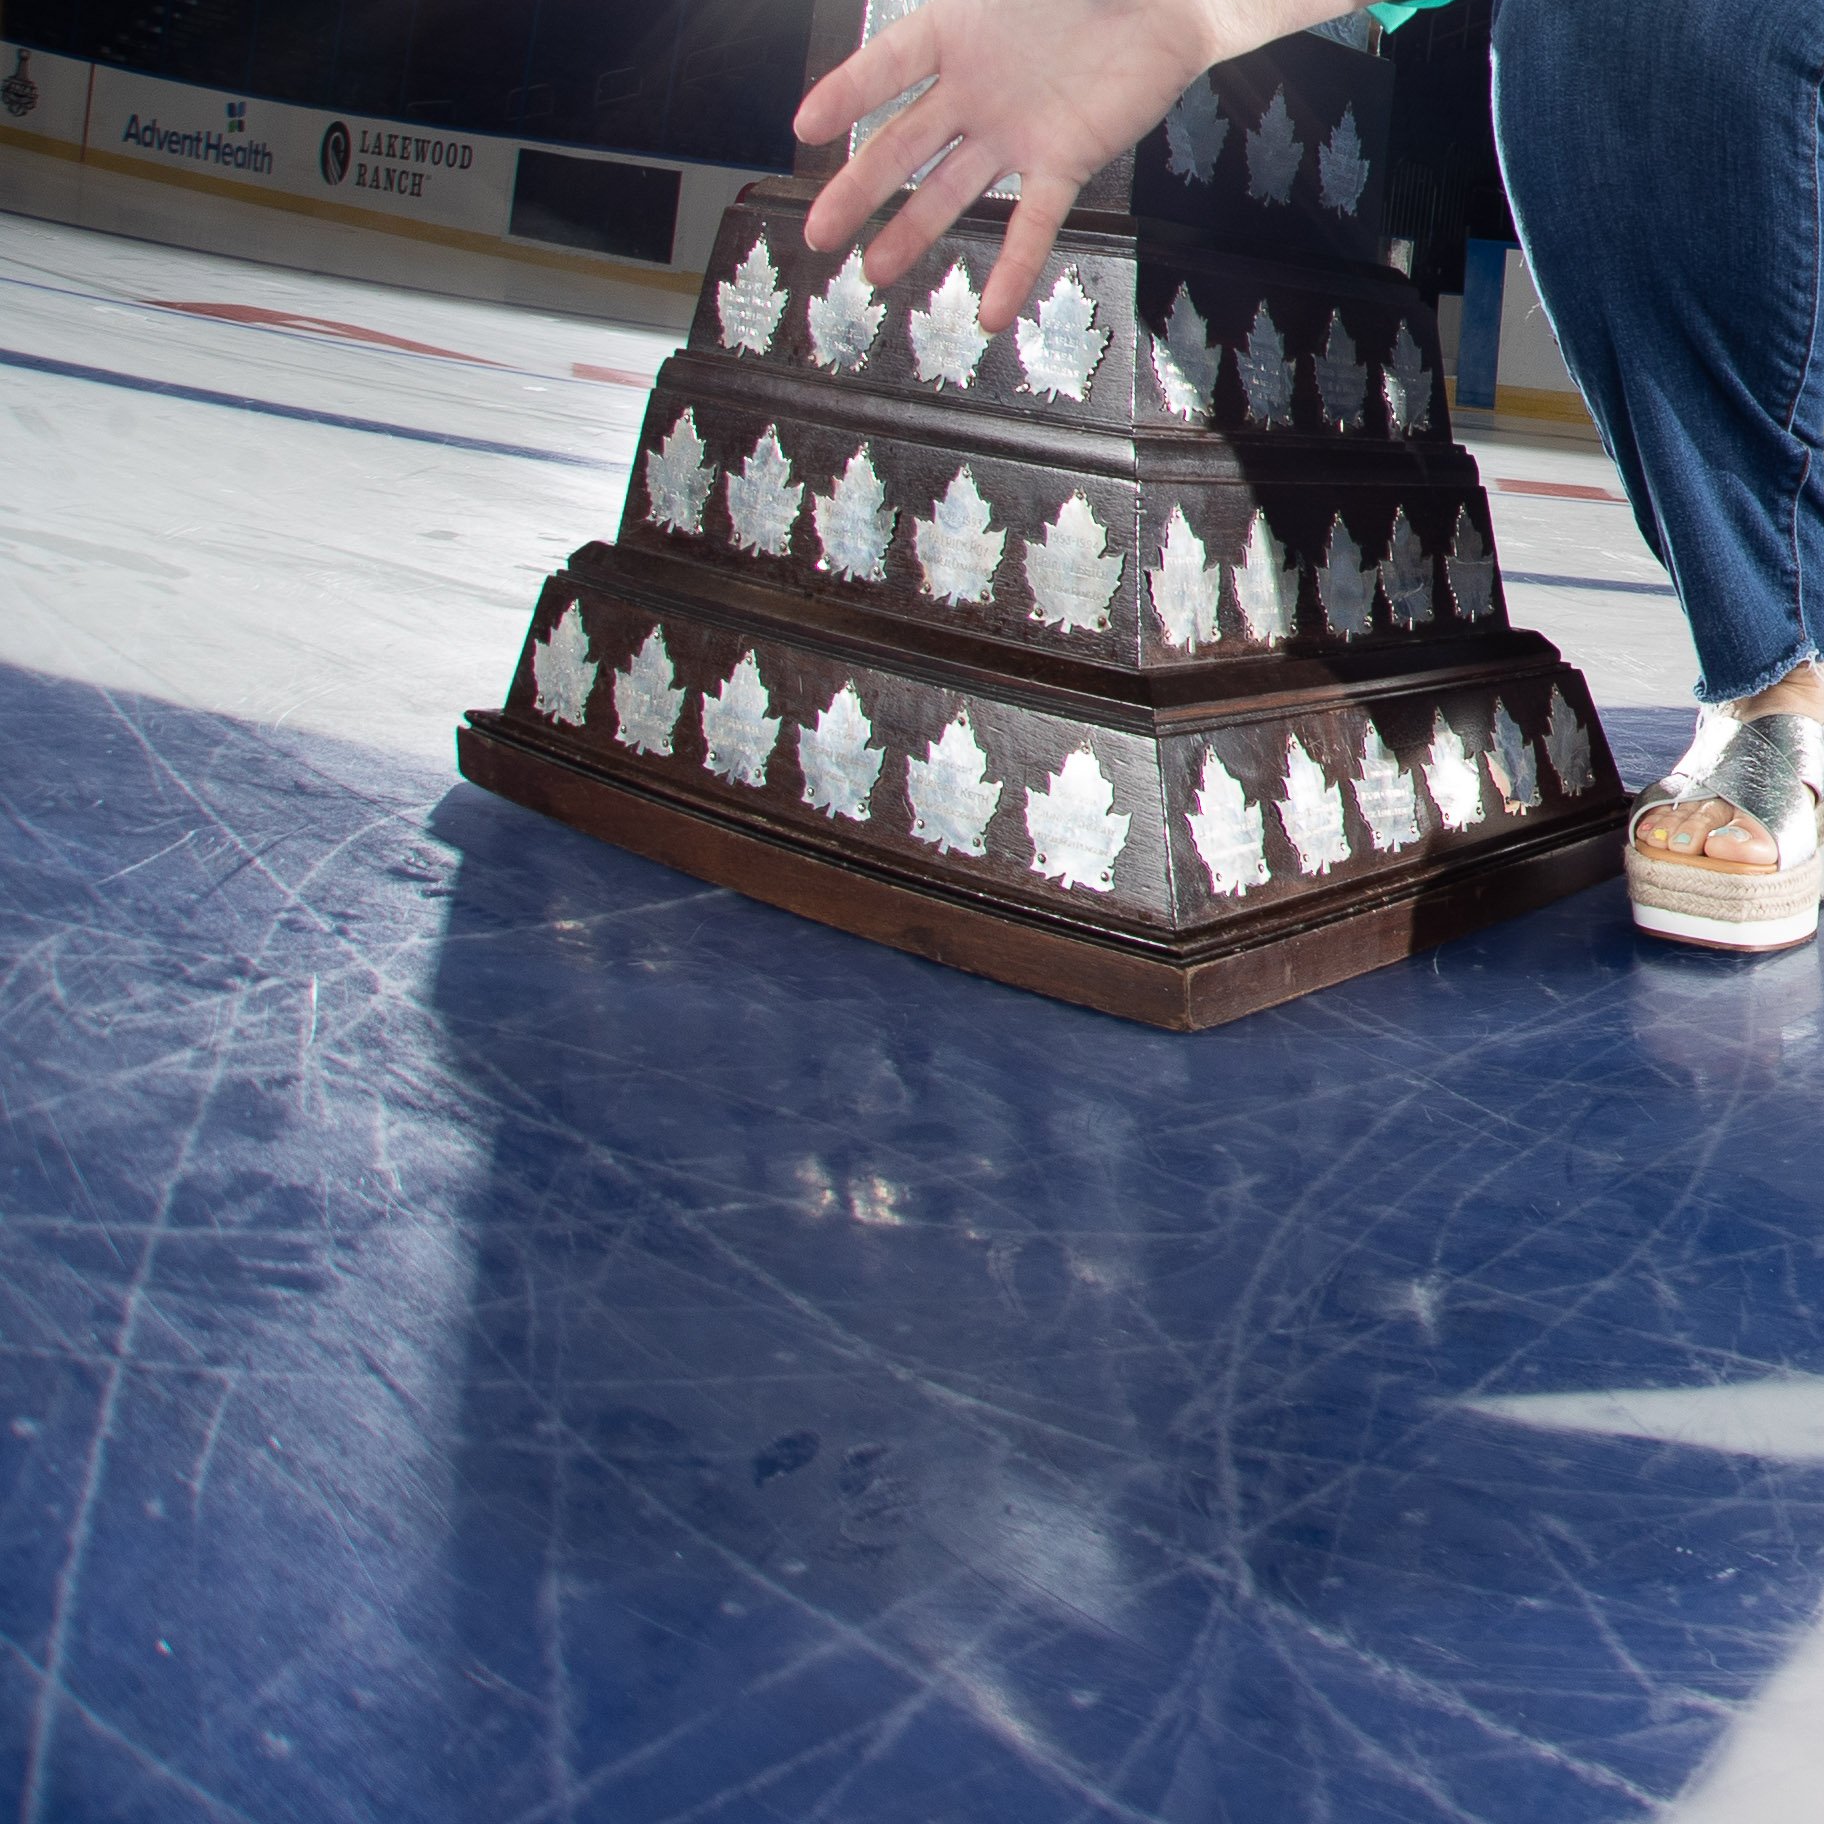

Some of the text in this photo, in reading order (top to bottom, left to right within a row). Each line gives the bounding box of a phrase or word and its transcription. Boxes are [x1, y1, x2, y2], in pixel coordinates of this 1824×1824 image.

[122, 114, 273, 175] AdventHealth
[359, 130, 473, 170] LAKEWOOD
[356, 163, 424, 197] RANCH
